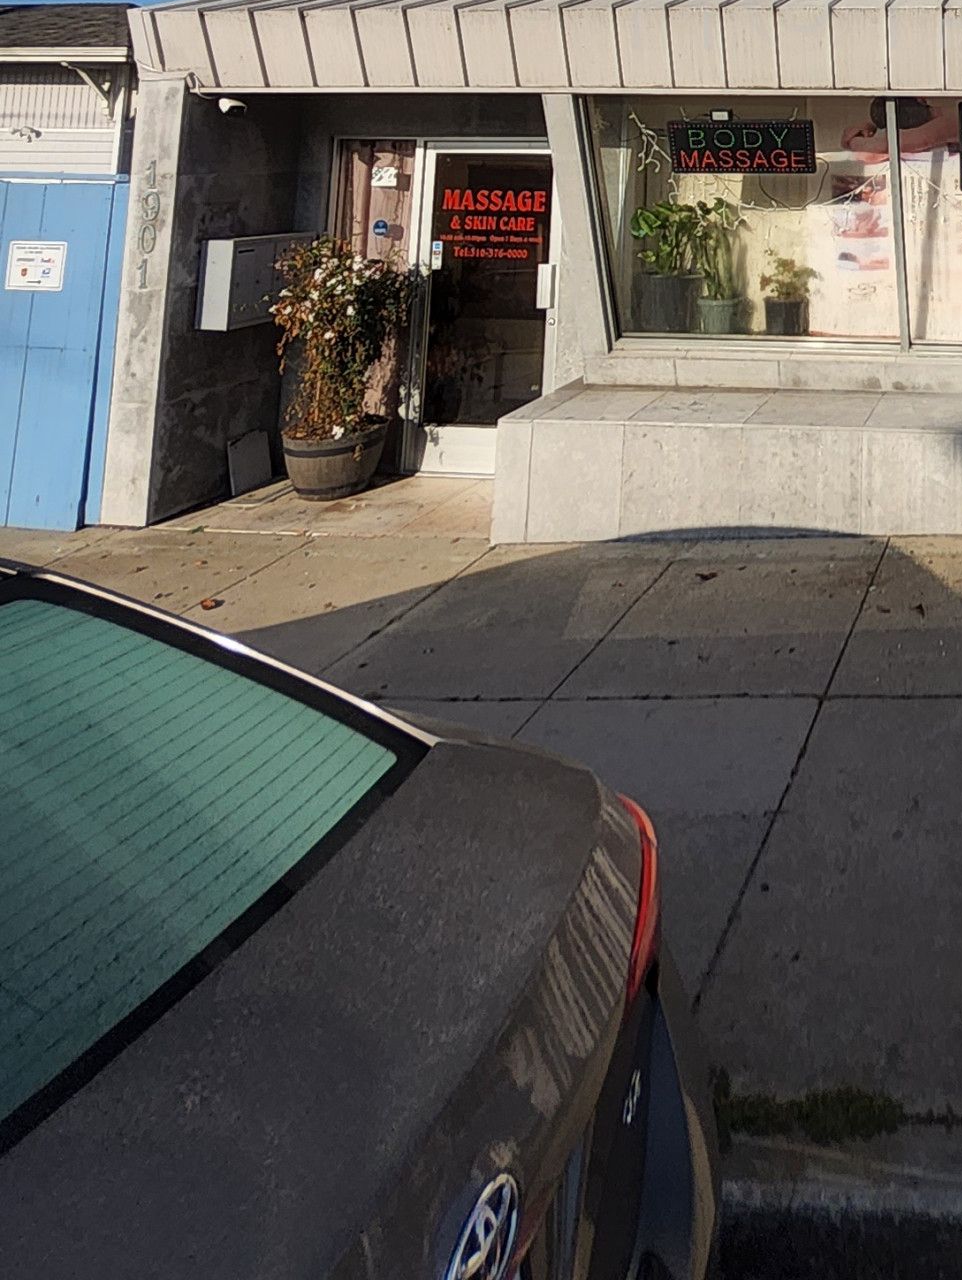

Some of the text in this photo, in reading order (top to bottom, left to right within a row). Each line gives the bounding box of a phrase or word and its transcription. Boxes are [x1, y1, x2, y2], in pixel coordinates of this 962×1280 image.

[688, 128, 788, 149] BODY
[680, 149, 807, 169] MASSAGE
[442, 188, 547, 212] MASSAGE
[136, 159, 160, 289] 1901
[450, 214, 535, 232] & SKIN CARE
